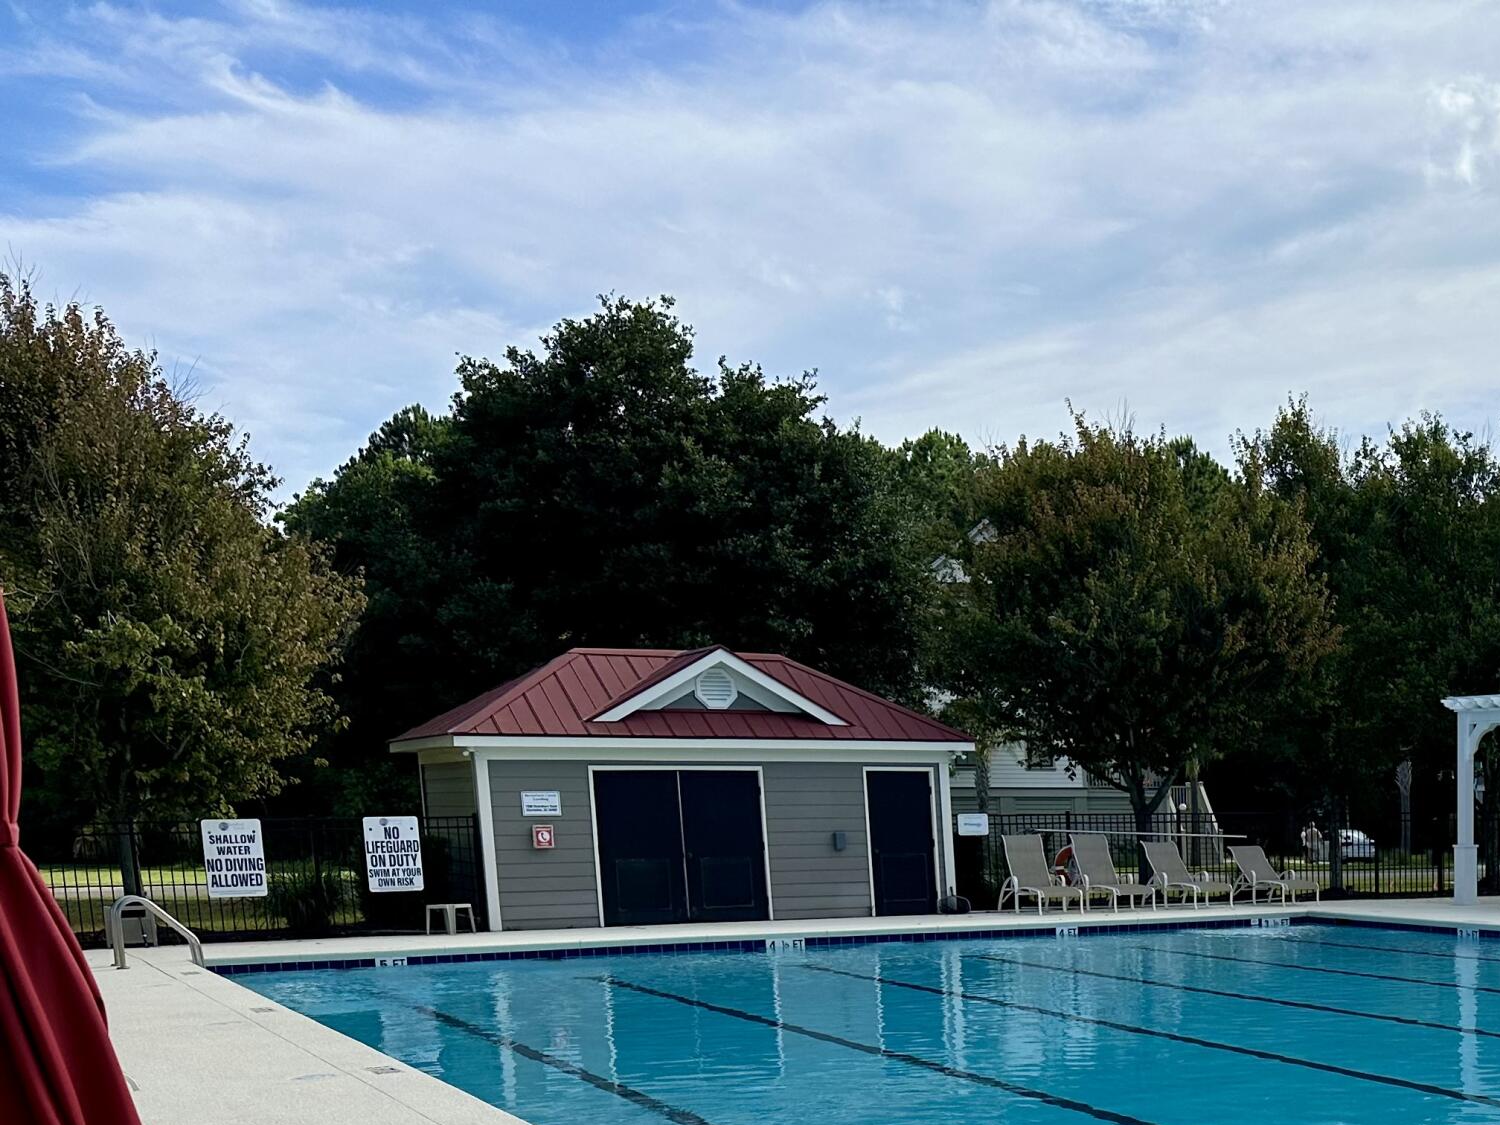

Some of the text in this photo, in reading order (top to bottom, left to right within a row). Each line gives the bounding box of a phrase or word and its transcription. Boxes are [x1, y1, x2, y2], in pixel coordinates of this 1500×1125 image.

[384, 826, 400, 840] NO
[208, 834, 256, 845] SHALLOW
[216, 845, 251, 856] WATER
[366, 840, 420, 854] LIFEGUARD
[206, 857, 264, 873] NO DIVING
[370, 854, 417, 868] ON DUTY
[369, 867, 422, 878] SWIM AT YOUR
[211, 873, 264, 888] ALLOWED
[378, 877, 415, 887] OWN RISK
[393, 958, 406, 967] FT
